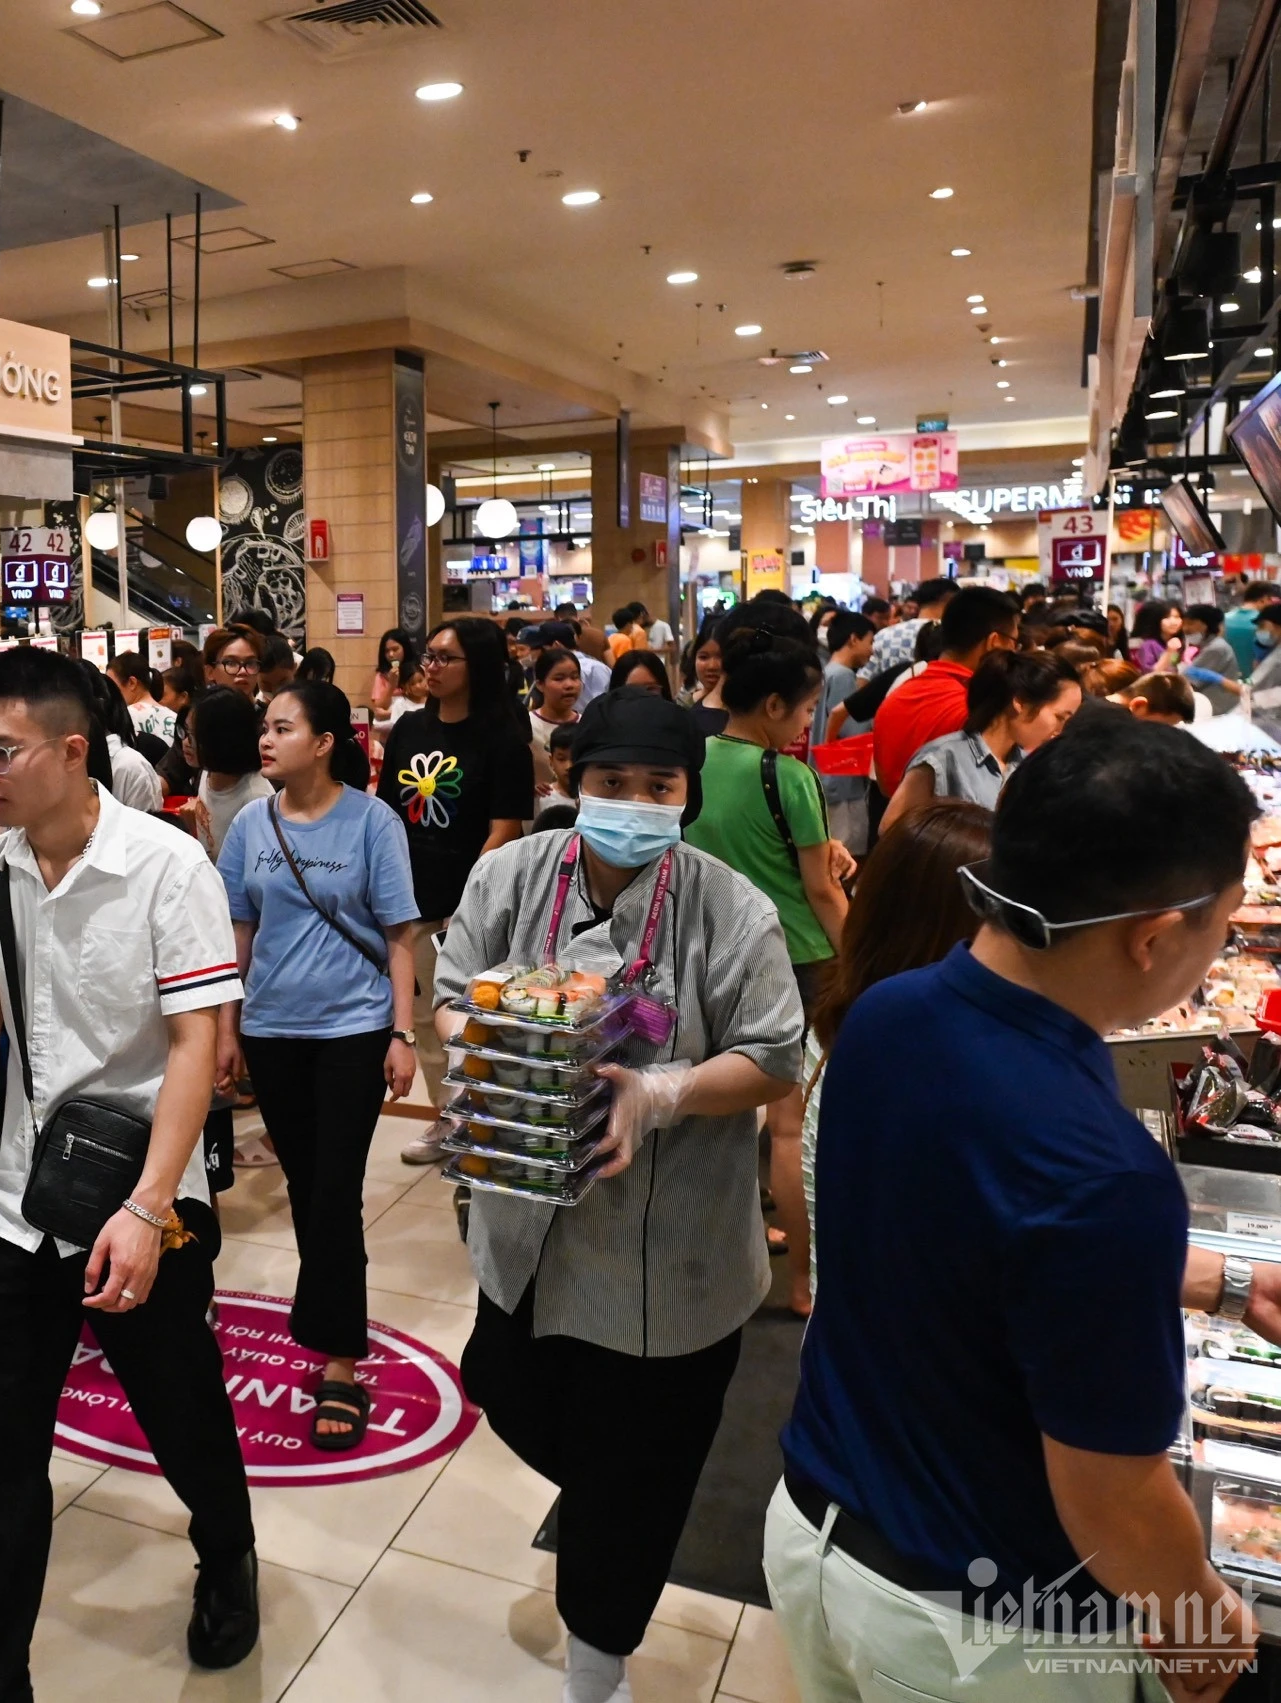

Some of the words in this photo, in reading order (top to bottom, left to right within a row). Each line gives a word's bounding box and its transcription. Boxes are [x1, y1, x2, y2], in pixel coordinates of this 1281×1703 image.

[800, 497, 853, 523] Siêu
[856, 495, 896, 523] Thị
[1063, 515, 1093, 534] 43
[9, 533, 32, 553] 42
[47, 533, 64, 552] 42
[1065, 567, 1093, 578] VND
[11, 589, 32, 599] VND
[48, 589, 64, 599] VND
[290, 1360, 326, 1375] ÁC
[353, 1370, 378, 1386] TẠ
[248, 1430, 303, 1450] QUÝ
